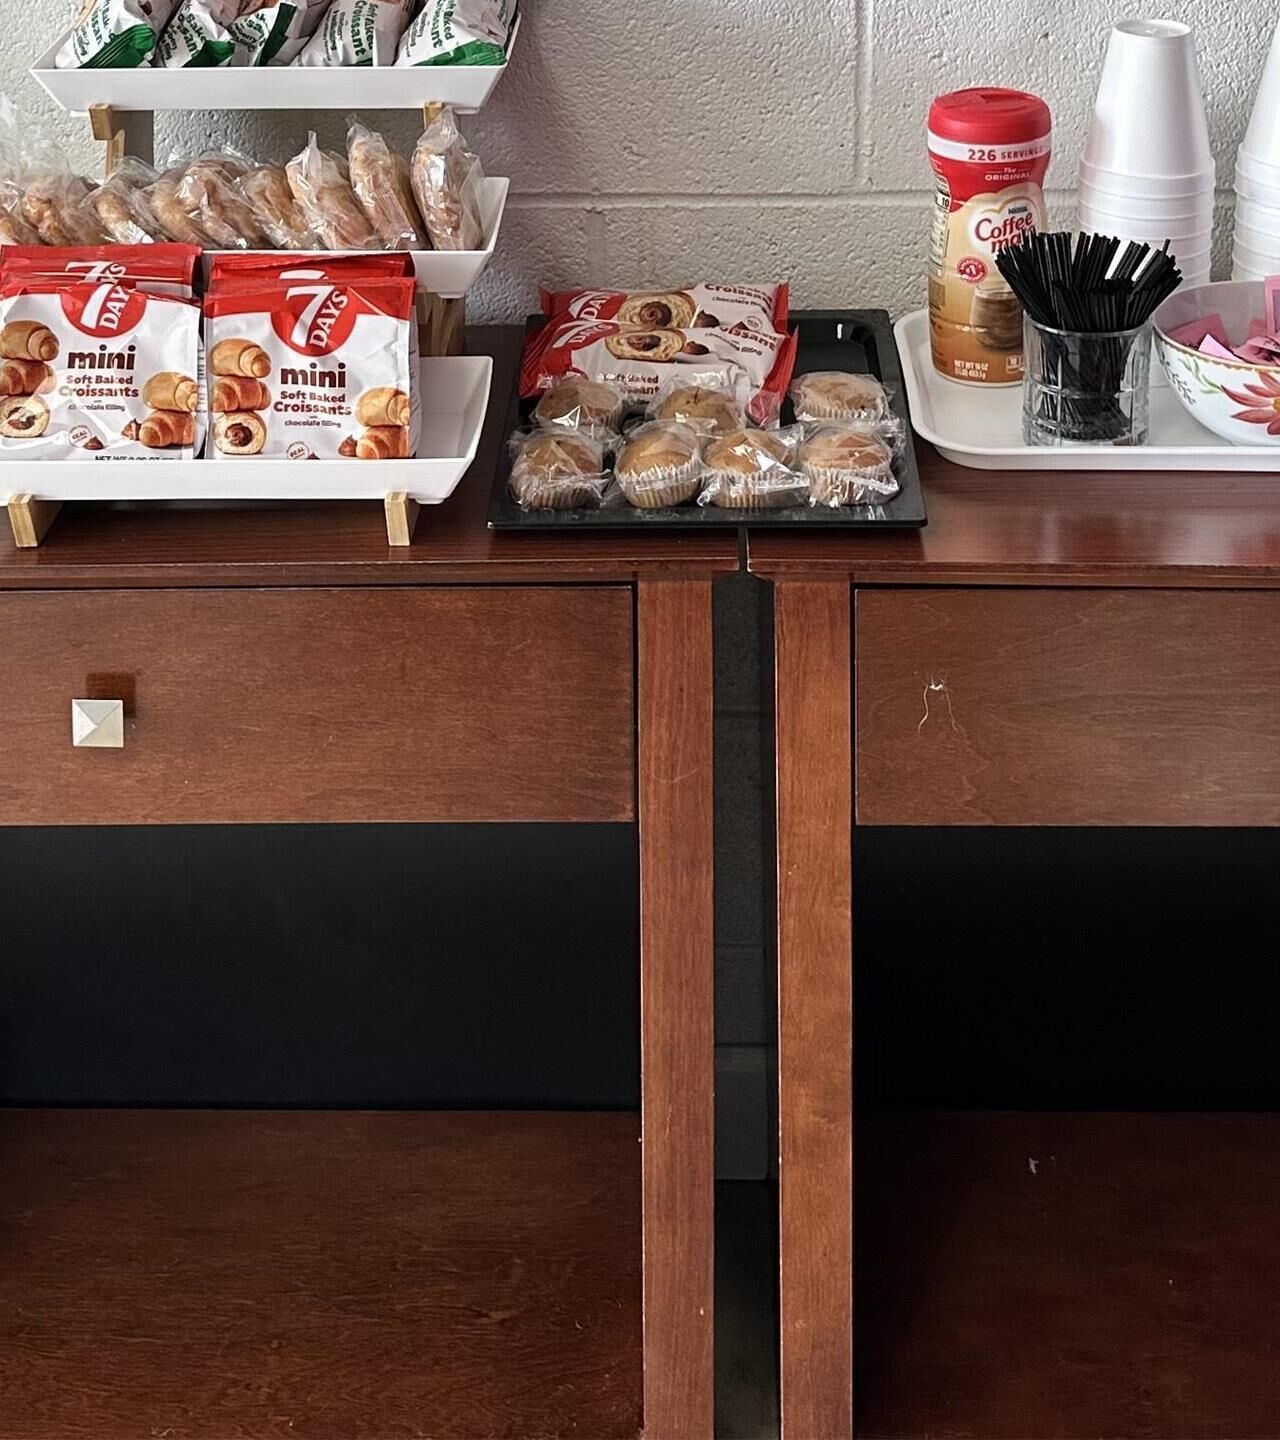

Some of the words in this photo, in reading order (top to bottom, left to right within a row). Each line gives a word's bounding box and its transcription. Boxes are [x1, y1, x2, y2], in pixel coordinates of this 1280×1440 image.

[968, 148, 997, 161] 226
[984, 172, 1031, 181] ORIGINAL
[975, 212, 1033, 241] Coffee
[285, 284, 337, 348] 7
[309, 290, 349, 348] DAYS
[67, 344, 136, 370] mini
[66, 374, 93, 385] Soft
[280, 362, 347, 388] mini
[58, 386, 140, 398] Croissants
[280, 390, 307, 401] Soft
[309, 392, 346, 403] Baked
[273, 401, 352, 417] Croissants
[284, 419, 321, 427] chocolate
